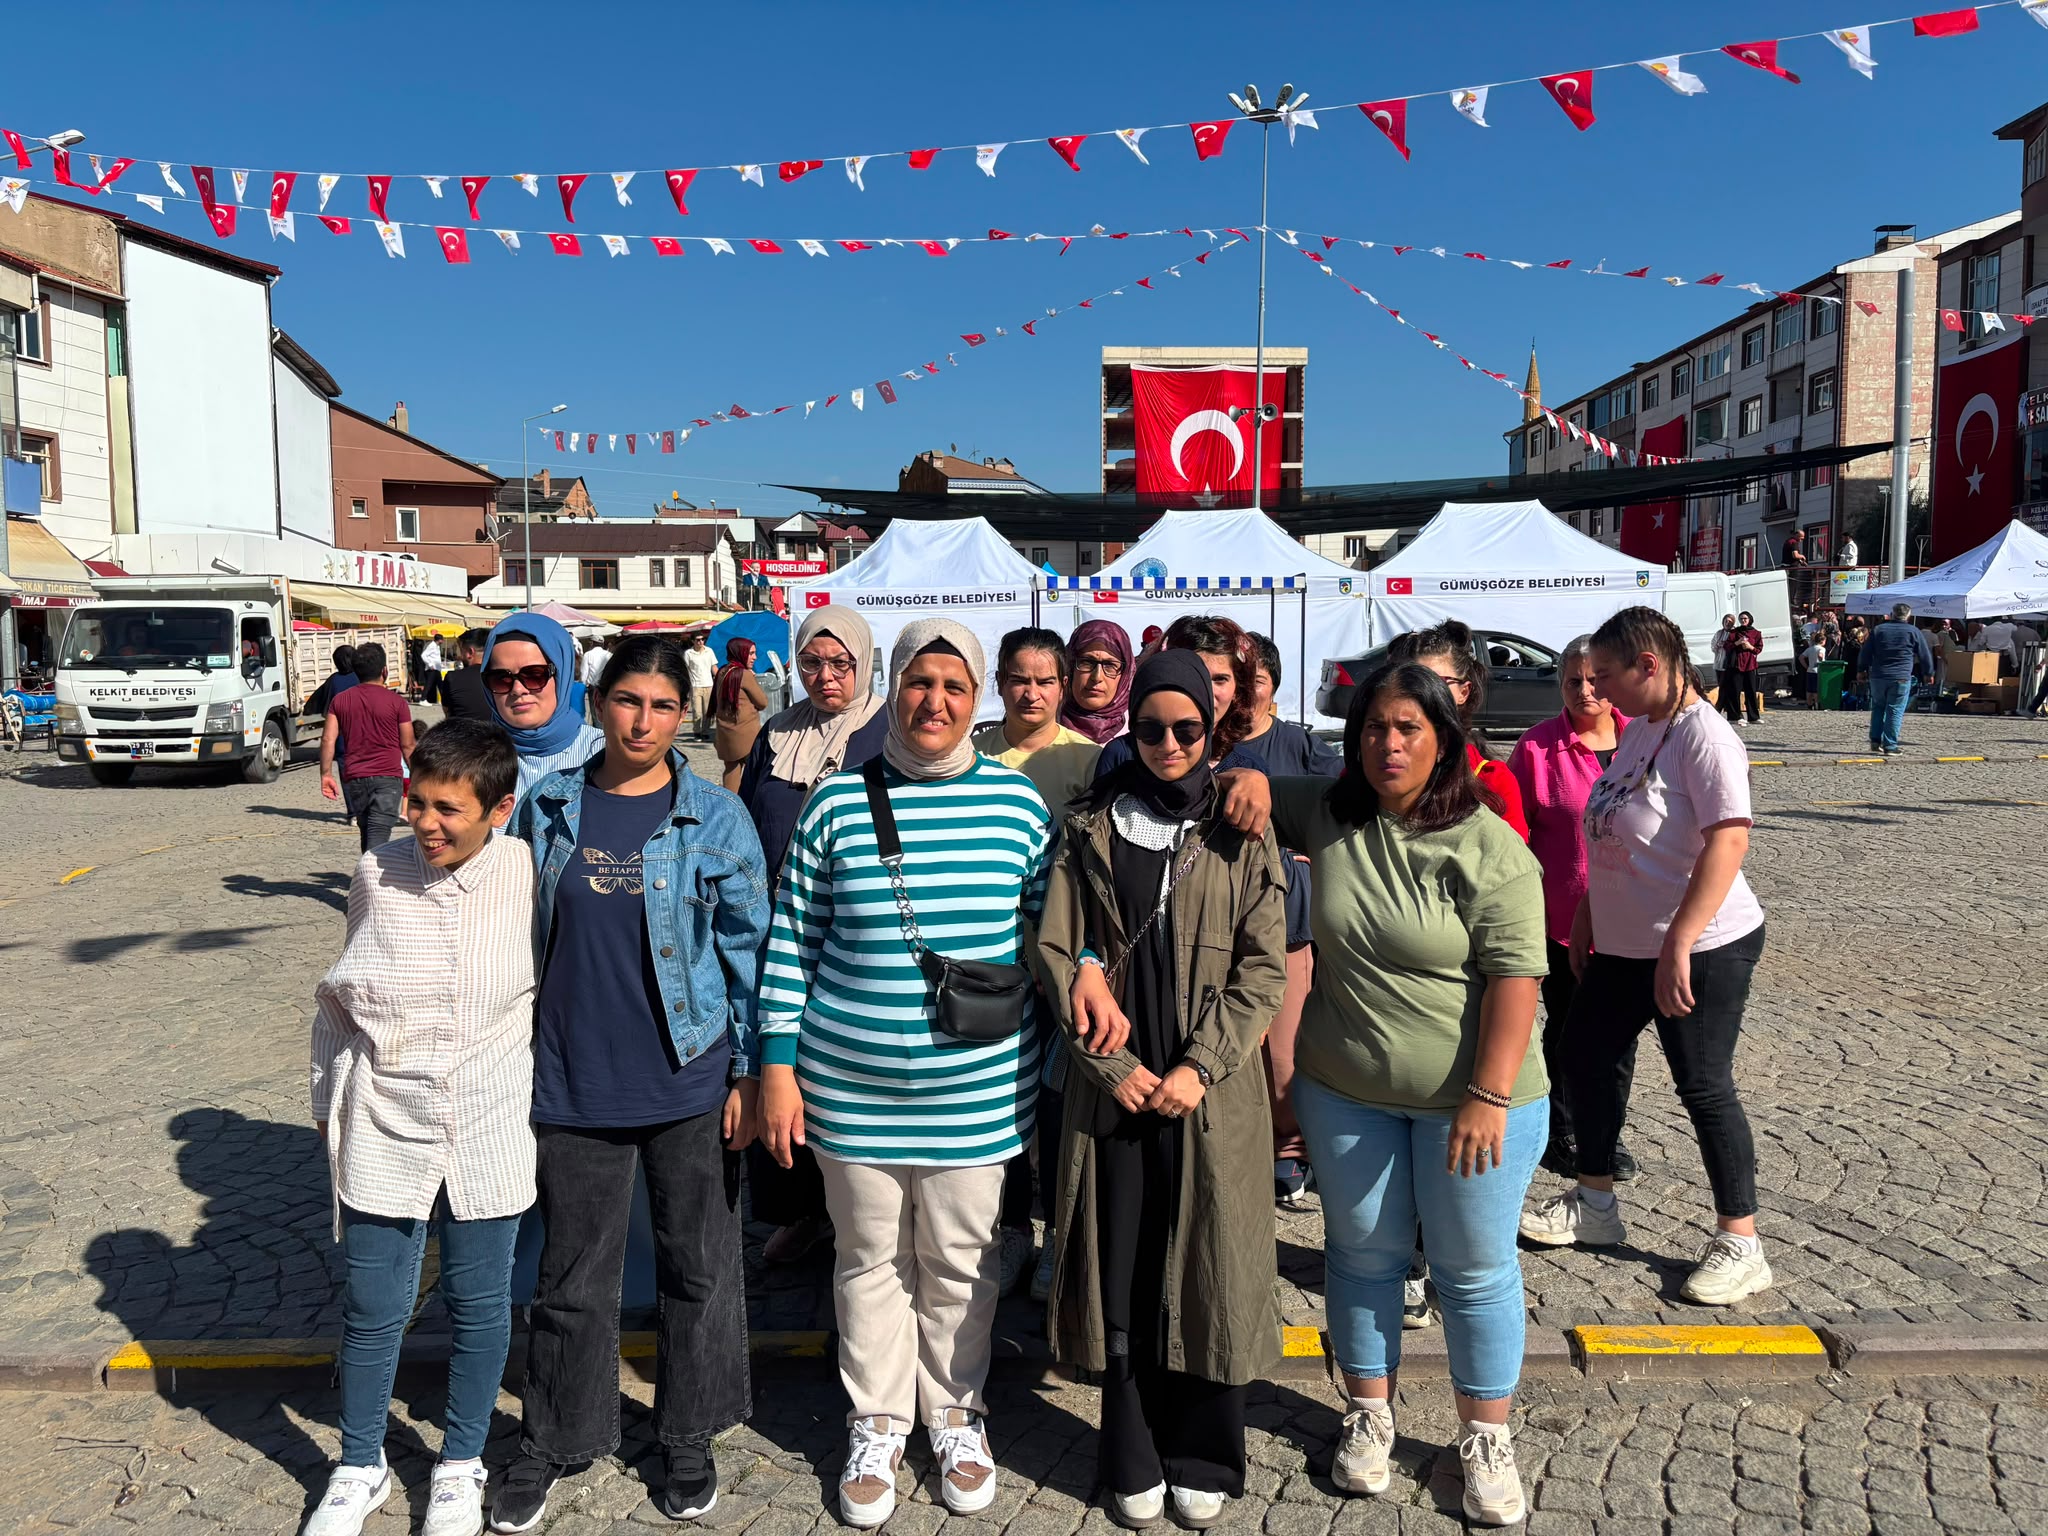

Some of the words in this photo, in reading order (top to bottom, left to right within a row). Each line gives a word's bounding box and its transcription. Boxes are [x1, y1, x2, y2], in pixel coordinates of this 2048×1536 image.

[2035, 404, 2048, 424] SA
[355, 556, 407, 588] TEMA
[766, 562, 820, 574] HOŞGELDİNİZ
[20, 581, 43, 592] RKAN
[1439, 578, 1524, 592] GÜMÜŞGÖZE
[1528, 575, 1605, 588] BELEDİYESİ
[856, 594, 938, 607] GÜMÜŞGÖZE
[942, 590, 1017, 604] BELEDİYESİ
[360, 614, 378, 622] TEMA
[90, 688, 128, 696] KELKİT
[131, 688, 196, 696] BELEDİYESİ
